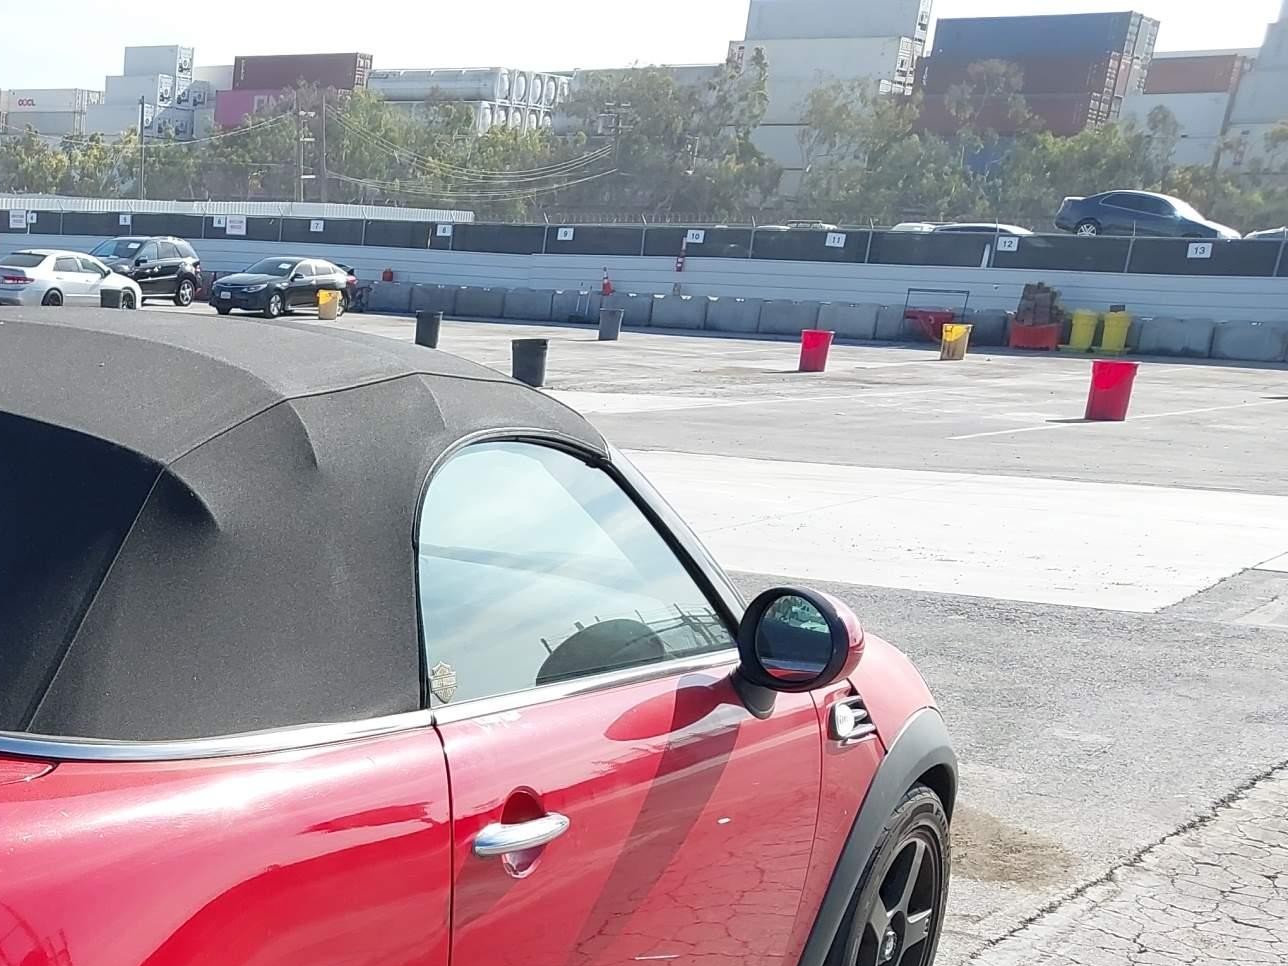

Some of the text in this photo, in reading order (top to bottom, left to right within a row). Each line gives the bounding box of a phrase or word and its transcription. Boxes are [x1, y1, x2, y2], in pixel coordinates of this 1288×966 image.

[691, 232, 701, 240] 10
[831, 236, 842, 244] 11
[1002, 240, 1014, 248] 12
[1193, 246, 1206, 255] 13
